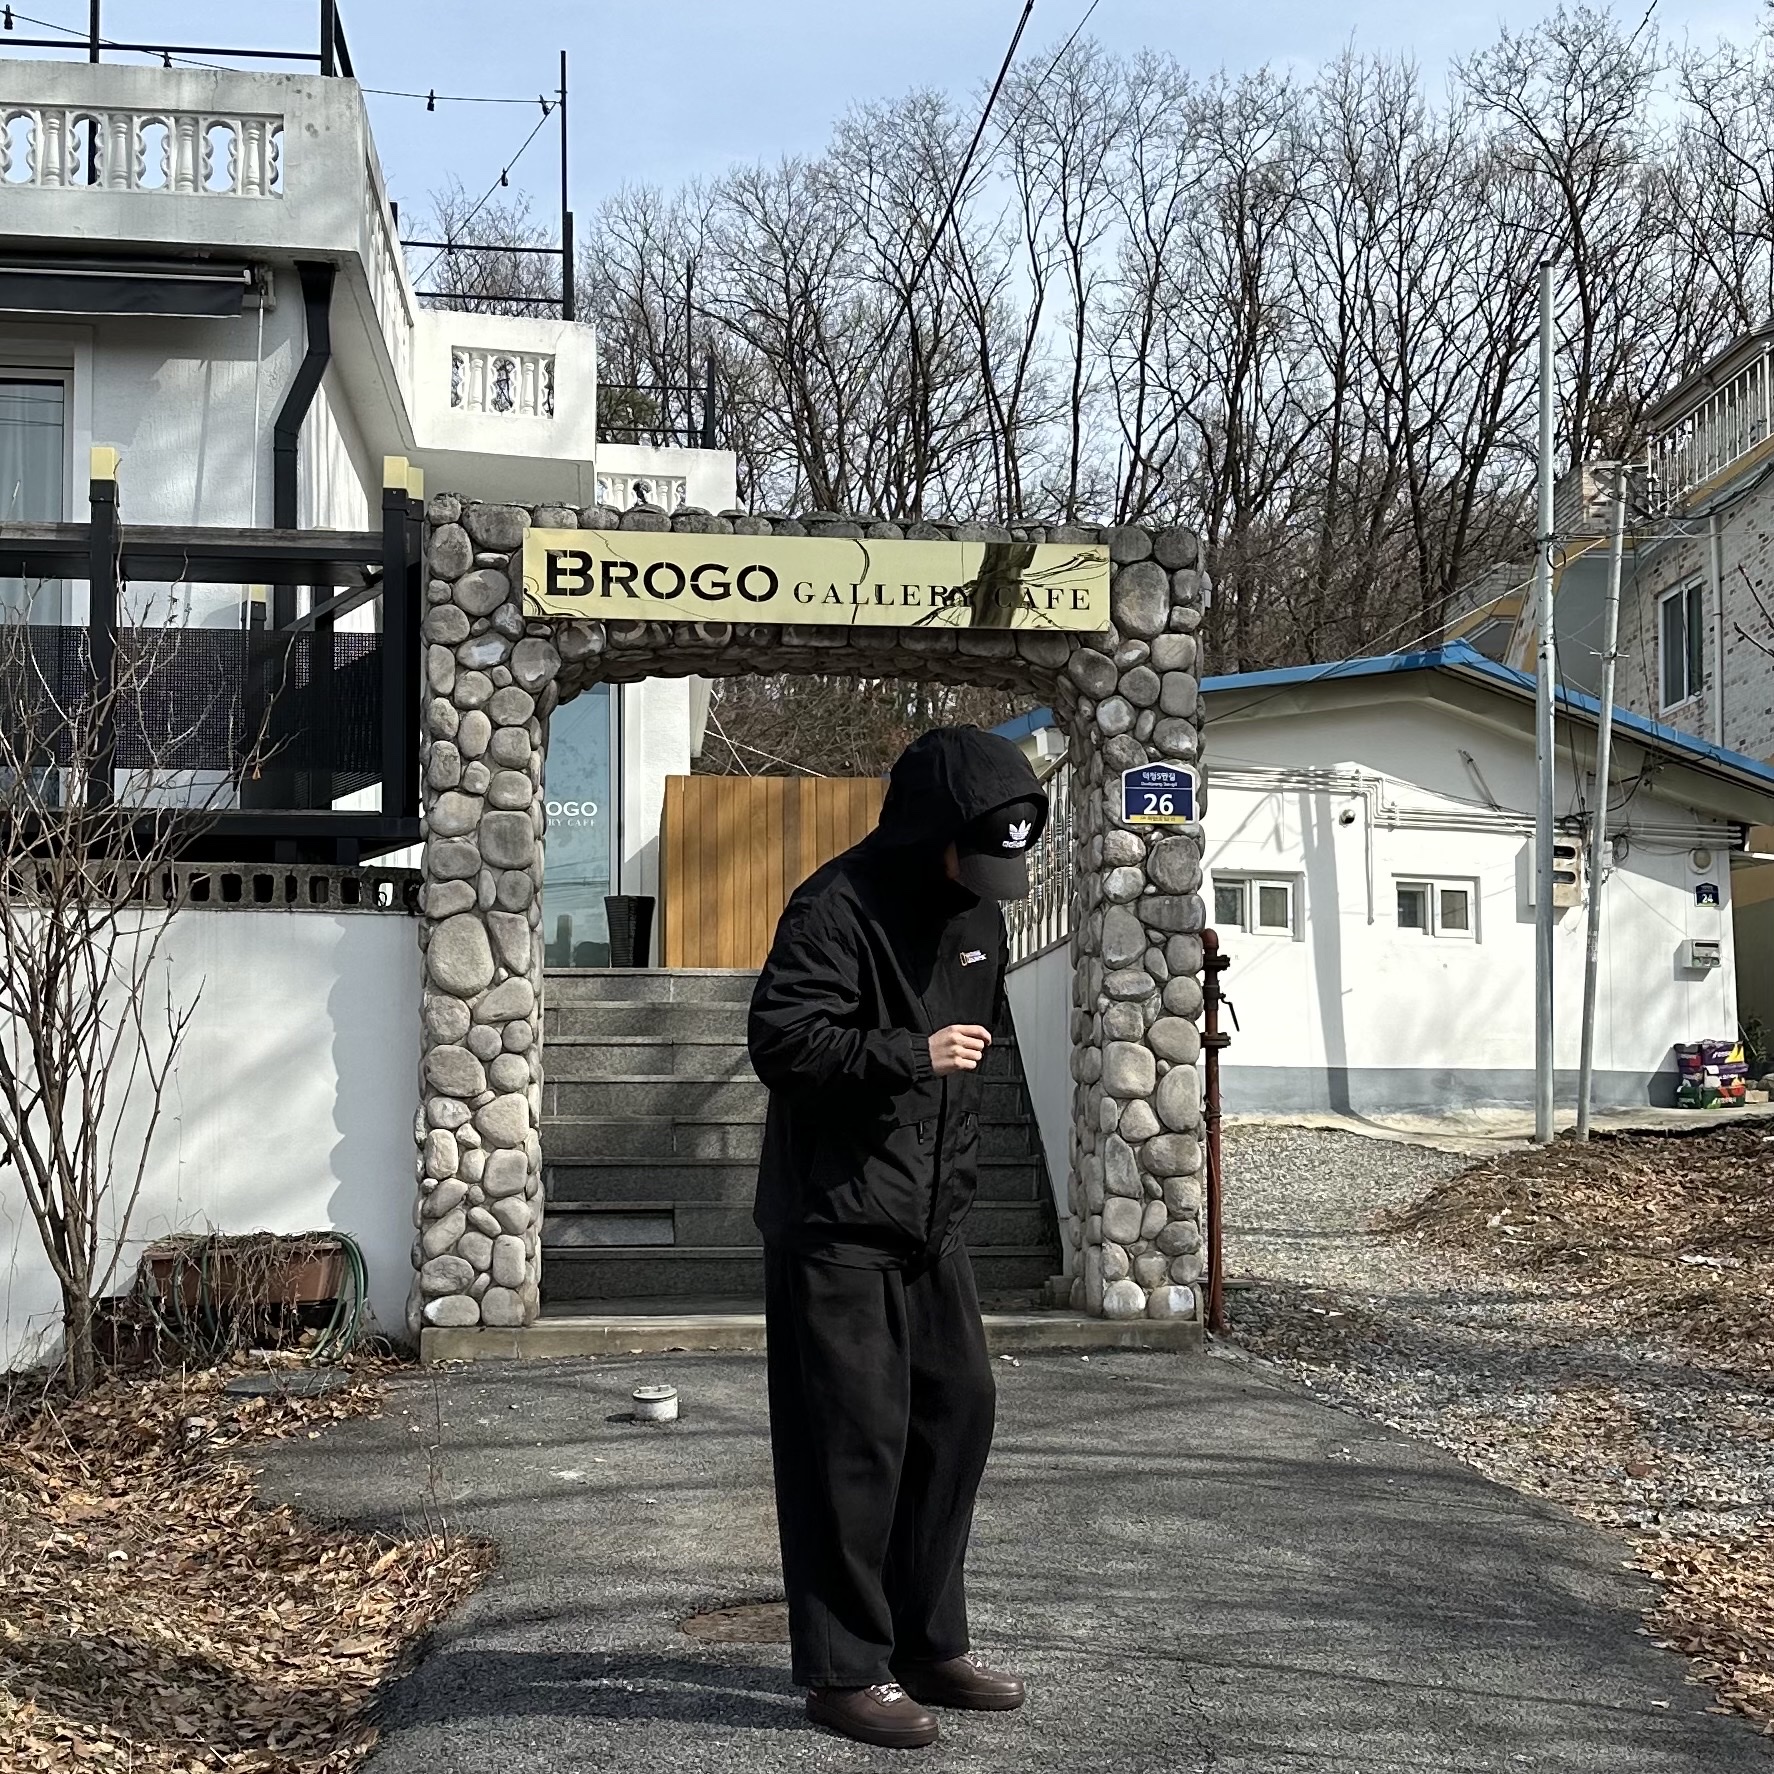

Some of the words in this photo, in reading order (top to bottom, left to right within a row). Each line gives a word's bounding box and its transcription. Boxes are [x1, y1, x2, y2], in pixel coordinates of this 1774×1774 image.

[545, 549, 779, 603] BROGO
[793, 581, 974, 608] GALLERY
[994, 586, 1091, 611] CAFE
[545, 801, 598, 817] OGO
[1143, 793, 1174, 815] 26
[1701, 893, 1714, 904] 24
